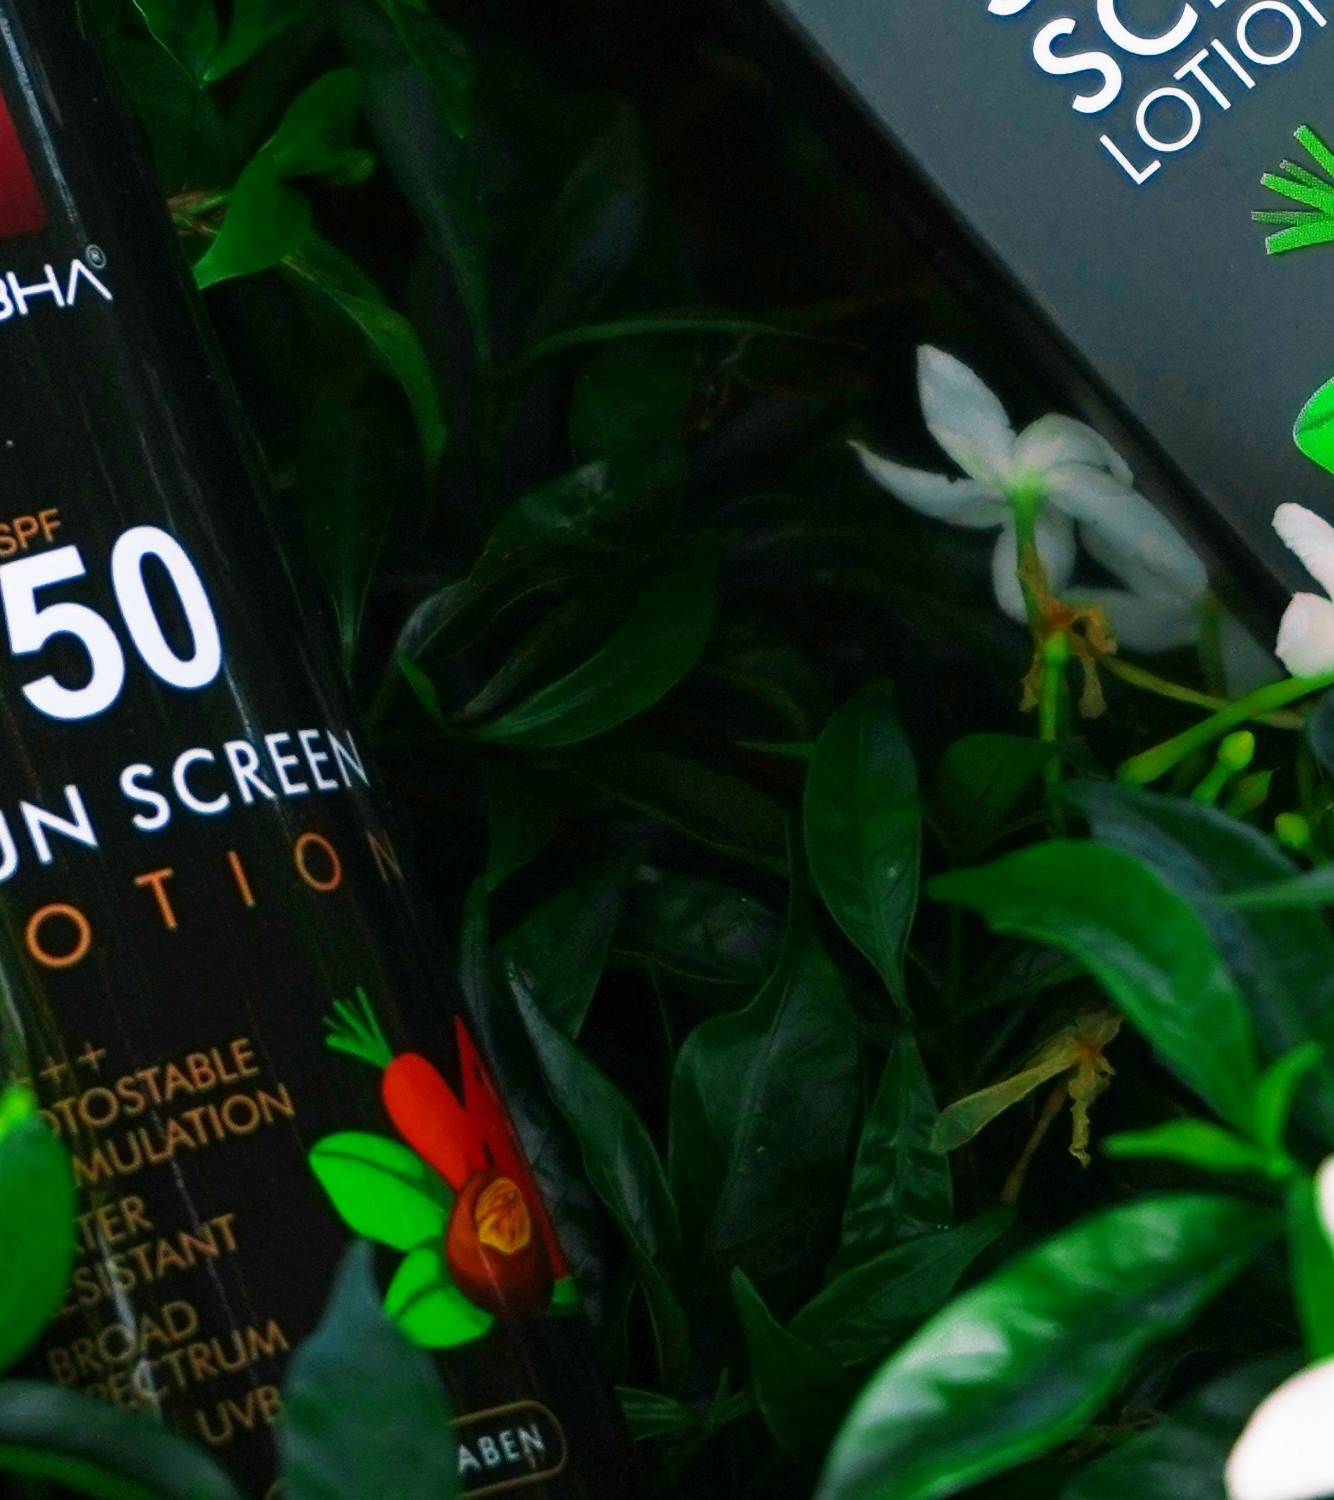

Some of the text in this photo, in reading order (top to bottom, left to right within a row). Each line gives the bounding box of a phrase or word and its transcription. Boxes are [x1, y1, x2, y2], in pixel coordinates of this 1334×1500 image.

[120, 728, 372, 832] SCREEN
[48, 1301, 200, 1386] BROAD
[456, 1422, 547, 1477] ABEN
